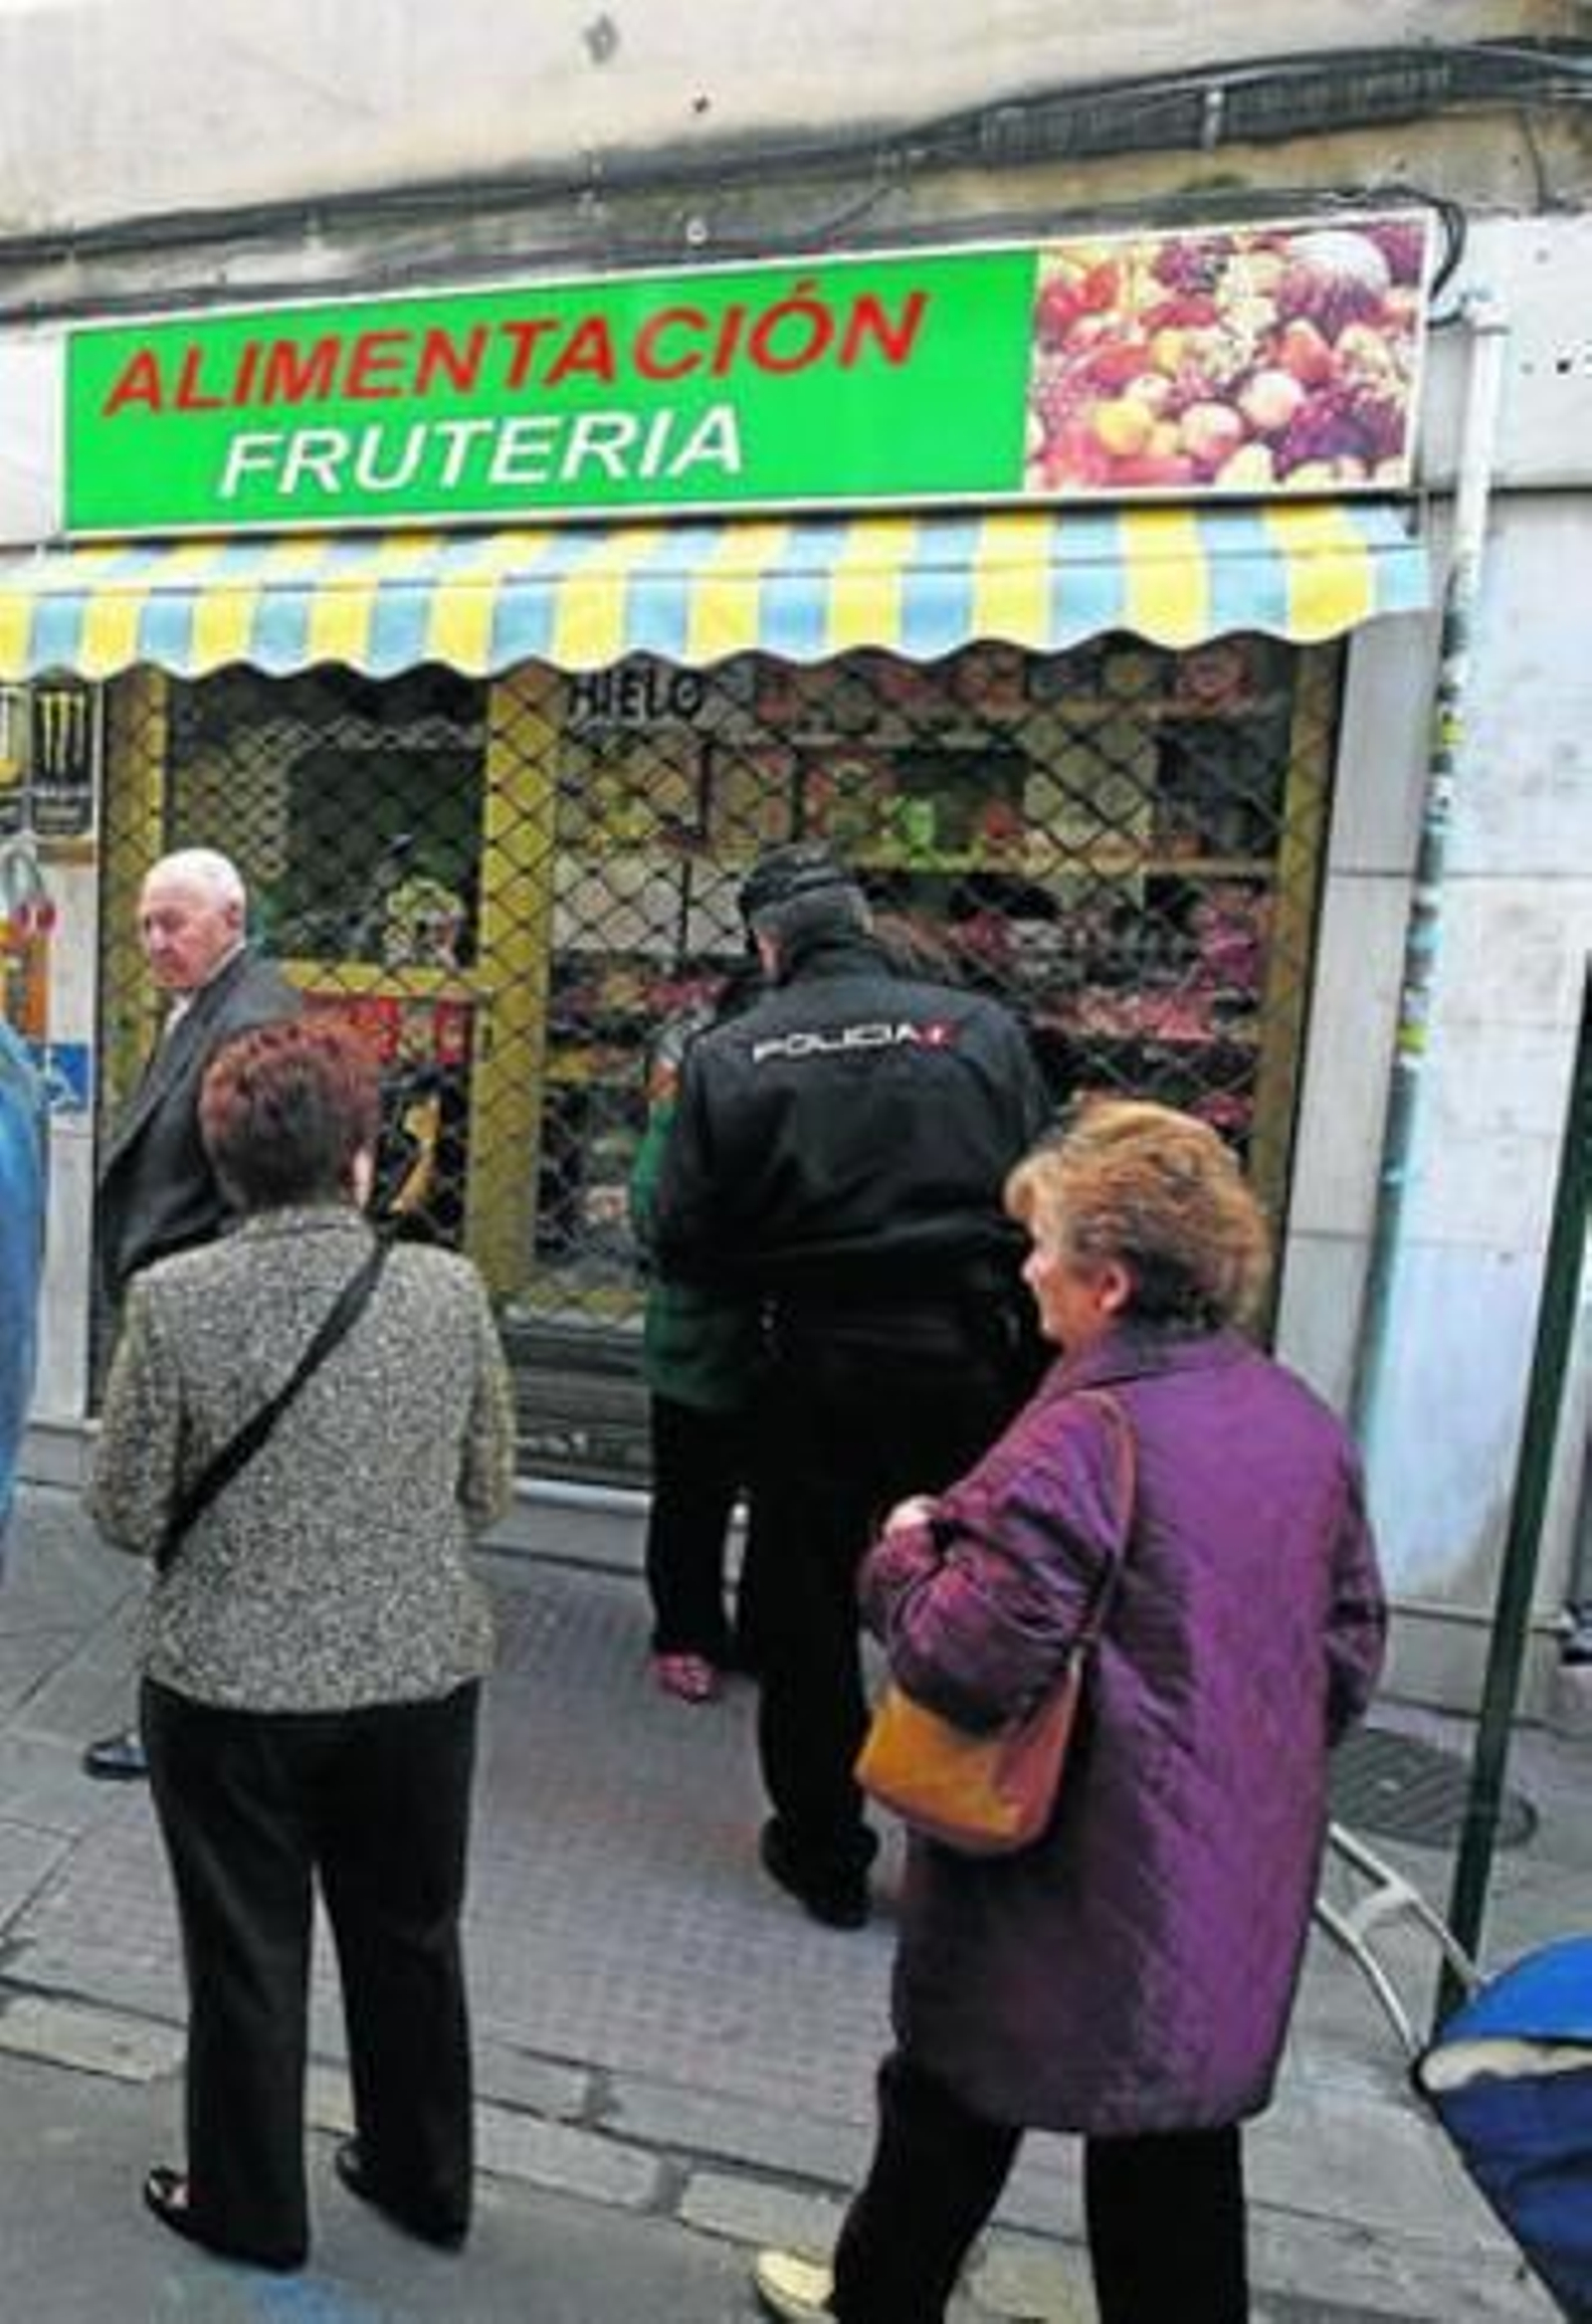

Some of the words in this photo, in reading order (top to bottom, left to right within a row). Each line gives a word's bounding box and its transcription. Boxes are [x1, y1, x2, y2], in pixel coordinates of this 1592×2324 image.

[102, 282, 928, 415] ALIMENTACIÓN
[218, 405, 744, 498] FRUTERIA
[570, 667, 702, 720] HIELO
[752, 1023, 920, 1065] POLICIA
